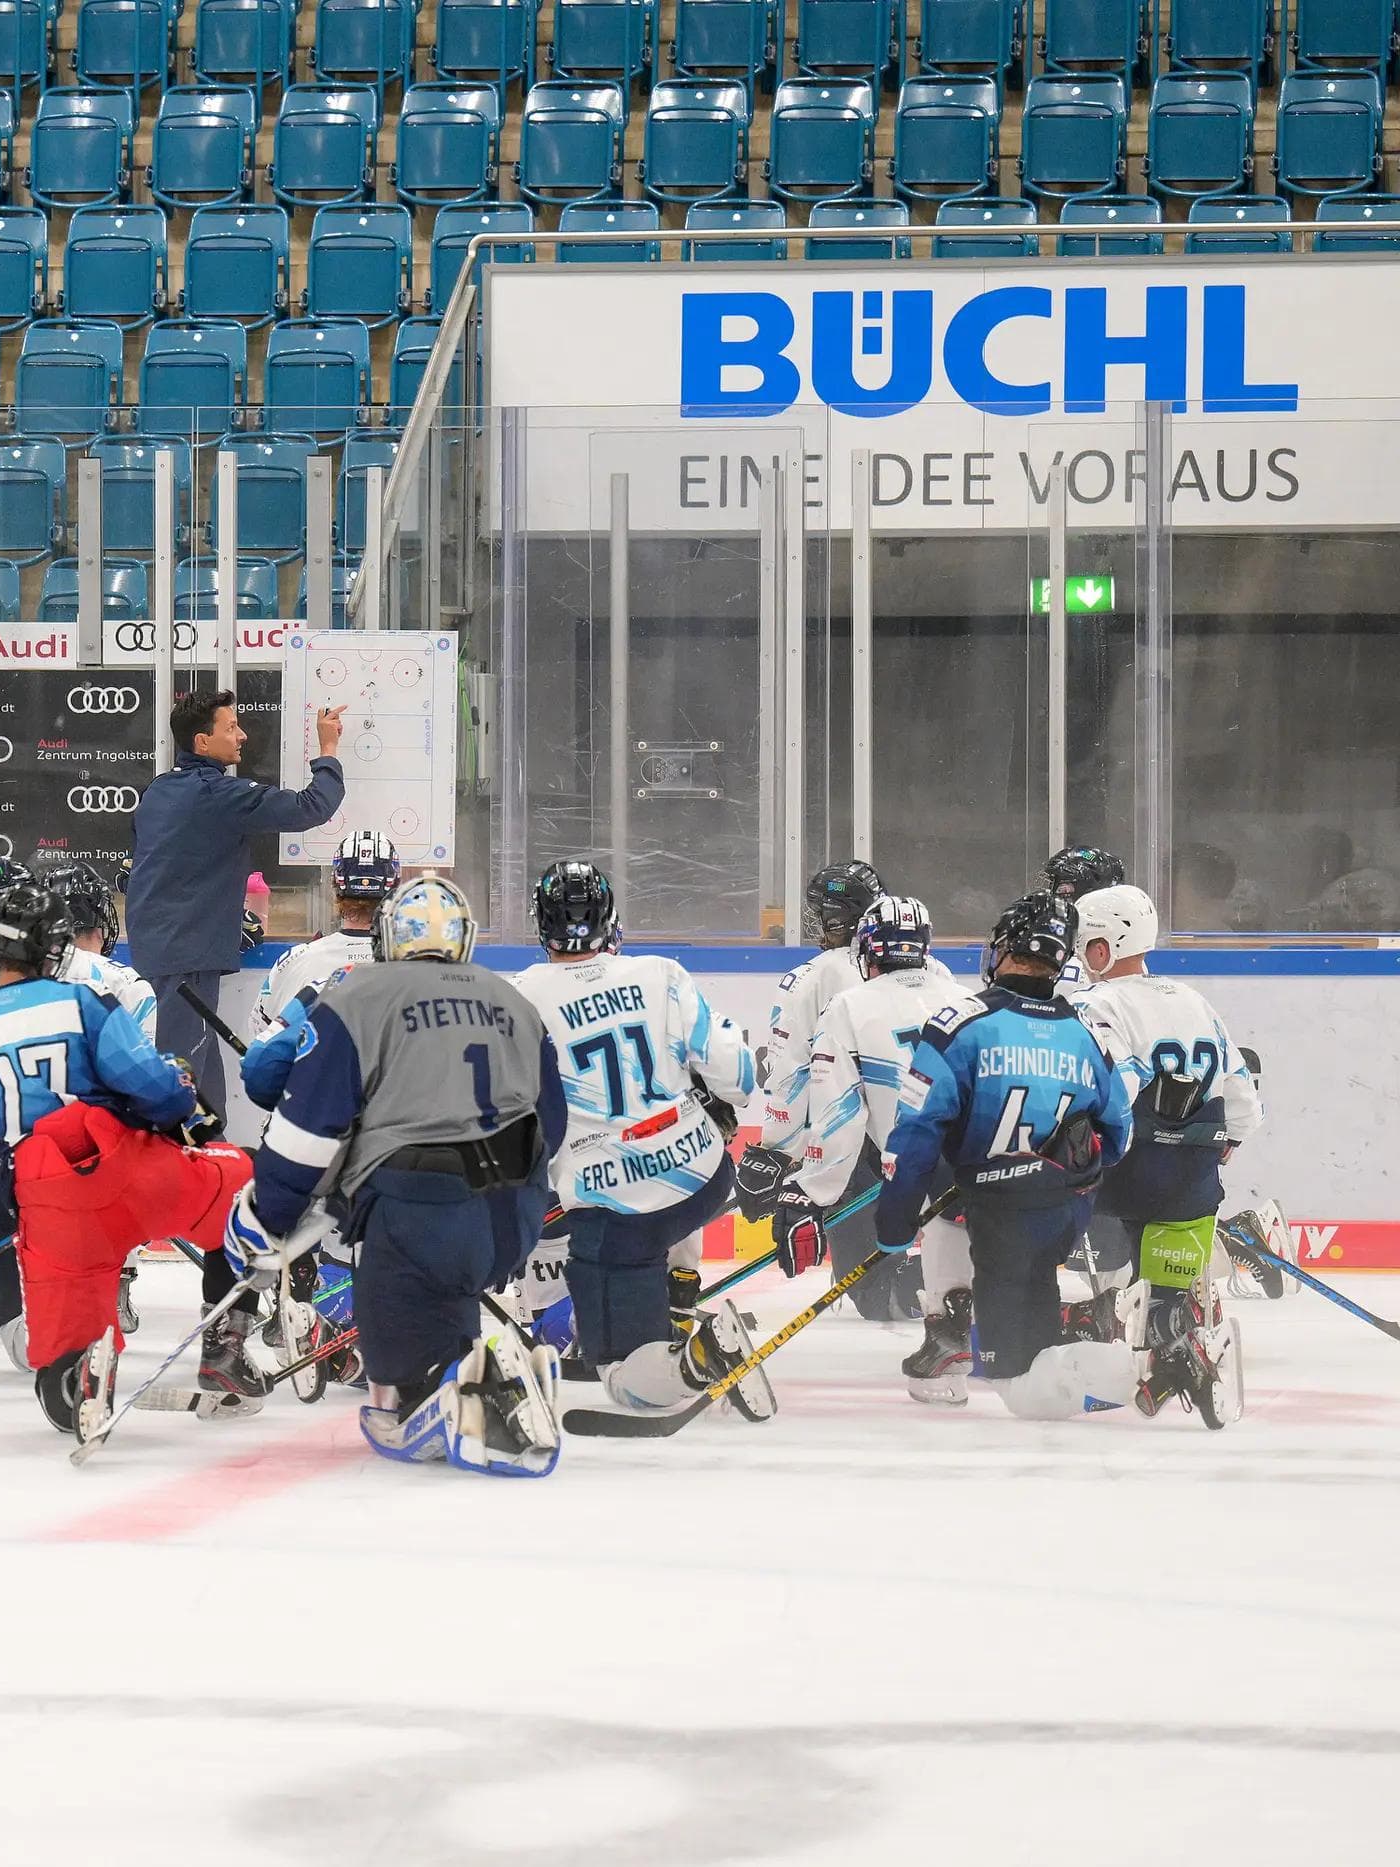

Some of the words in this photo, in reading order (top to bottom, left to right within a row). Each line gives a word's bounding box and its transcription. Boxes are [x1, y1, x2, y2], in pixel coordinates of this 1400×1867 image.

[681, 285, 1298, 418] BÜCHL
[870, 452, 995, 508] DEE
[37, 738, 68, 749] Audi
[37, 750, 92, 761] Zentrum
[37, 837, 68, 848] Audi
[37, 849, 92, 860] Zentrum
[566, 938, 582, 950] 71
[559, 984, 646, 1030] WEGNER
[568, 1020, 676, 1121] 71
[978, 1046, 1078, 1084] SCHINDLER
[464, 1043, 500, 1120] 1
[986, 1086, 1077, 1160] 4
[583, 1161, 618, 1193] ERC
[975, 1160, 1044, 1185] BAUER
[1152, 1246, 1199, 1263] ziegler
[1164, 1261, 1198, 1277] haus
[706, 1306, 818, 1401] SHERWOOD
